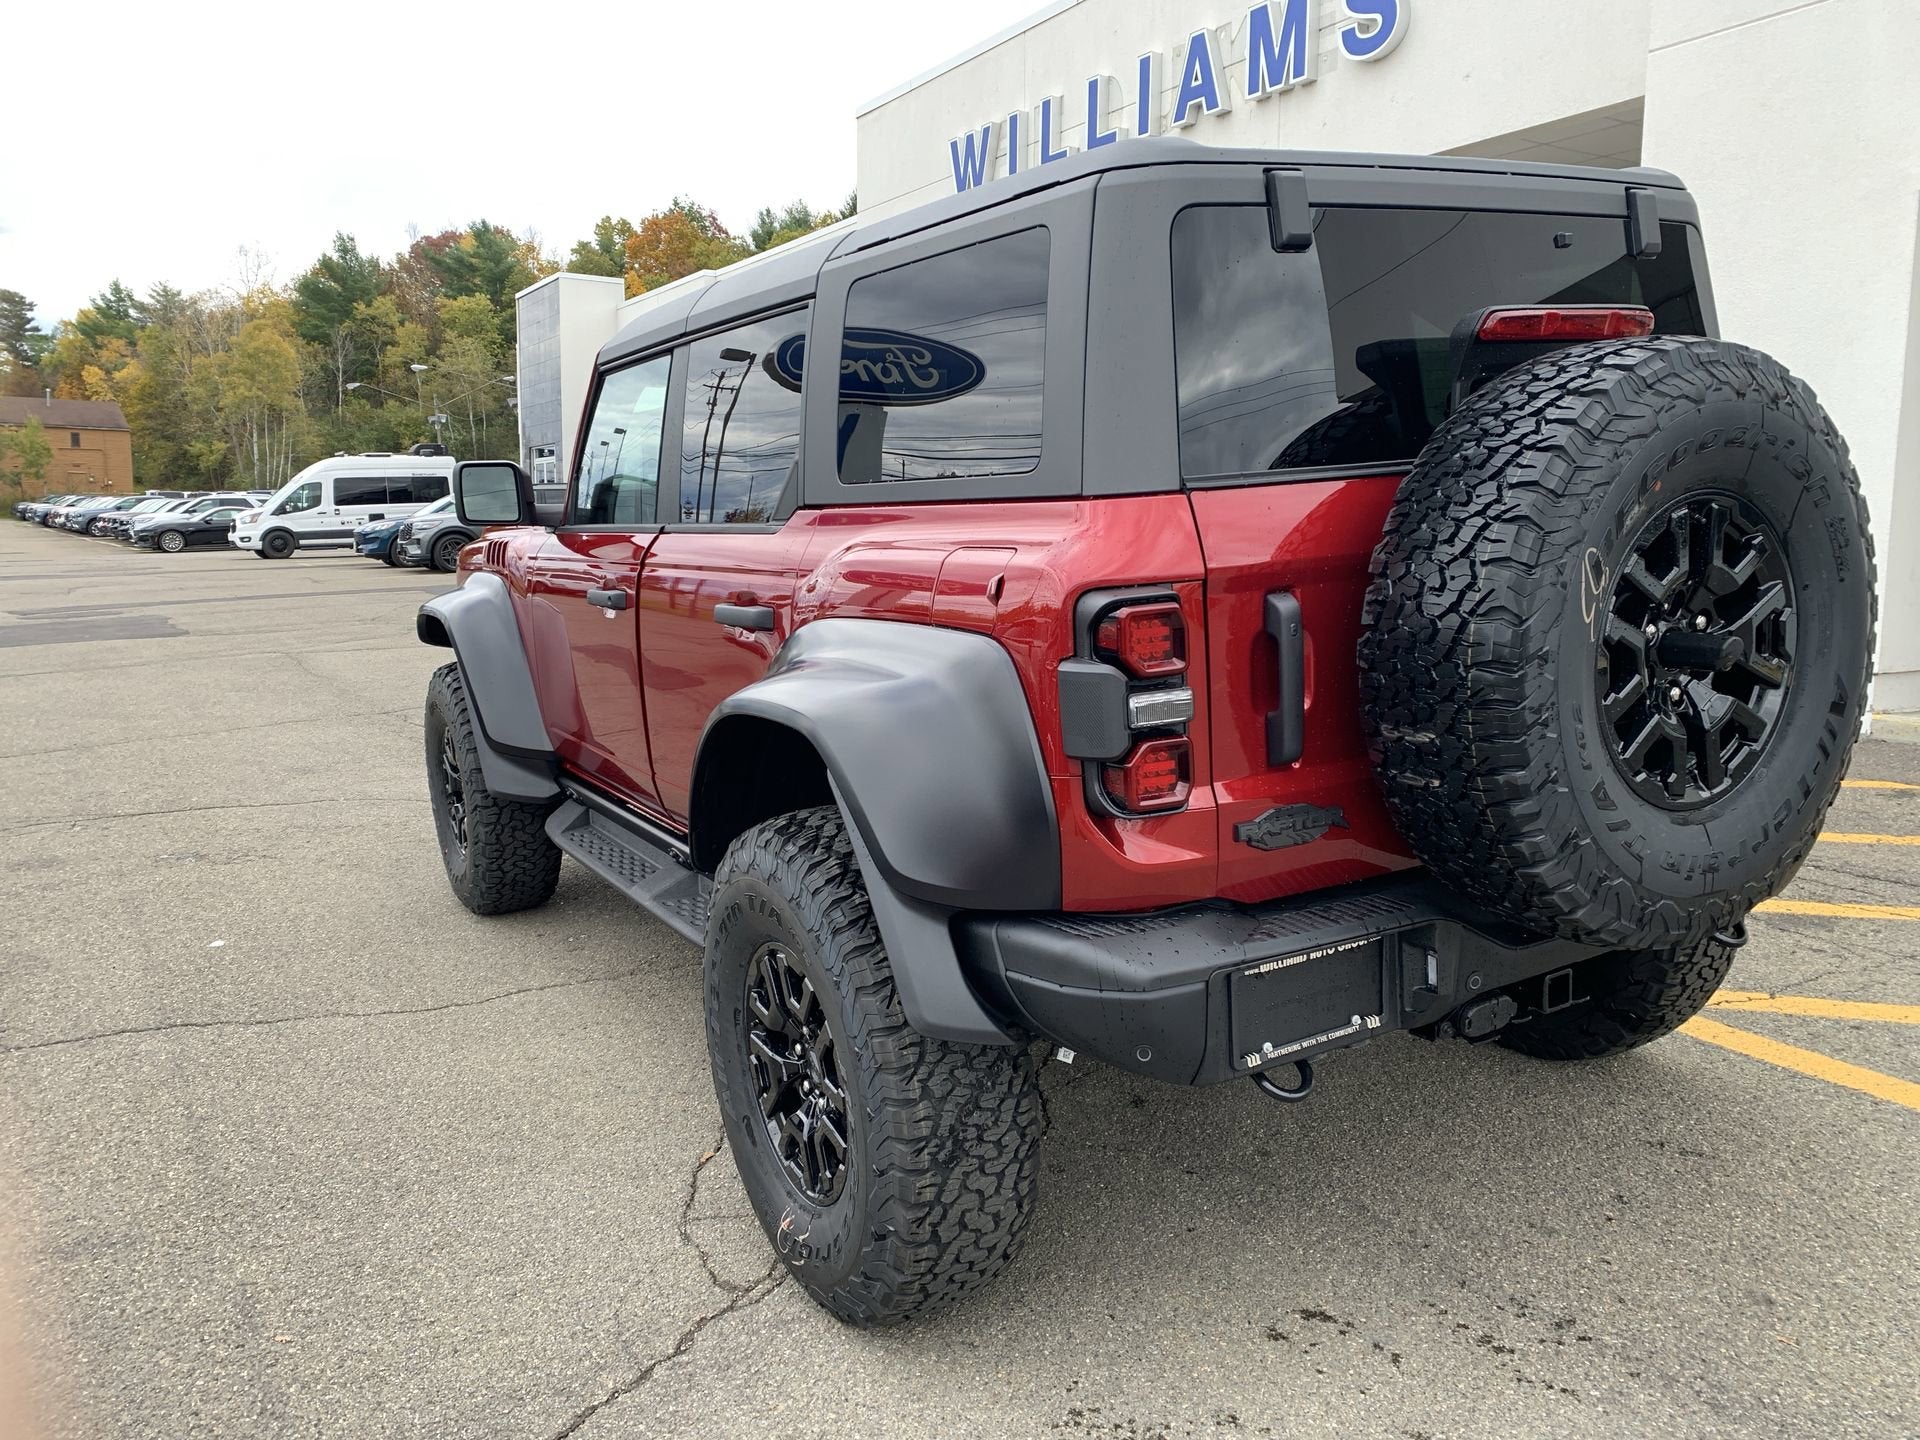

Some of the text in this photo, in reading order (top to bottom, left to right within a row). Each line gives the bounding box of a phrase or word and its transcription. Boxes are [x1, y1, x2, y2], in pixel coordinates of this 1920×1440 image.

[947, 0, 1404, 193] WILLIAMS
[1237, 806, 1351, 846] RAPTOR
[1267, 1024, 1360, 1060] PARTNERING WITH THE COMMUNITY
